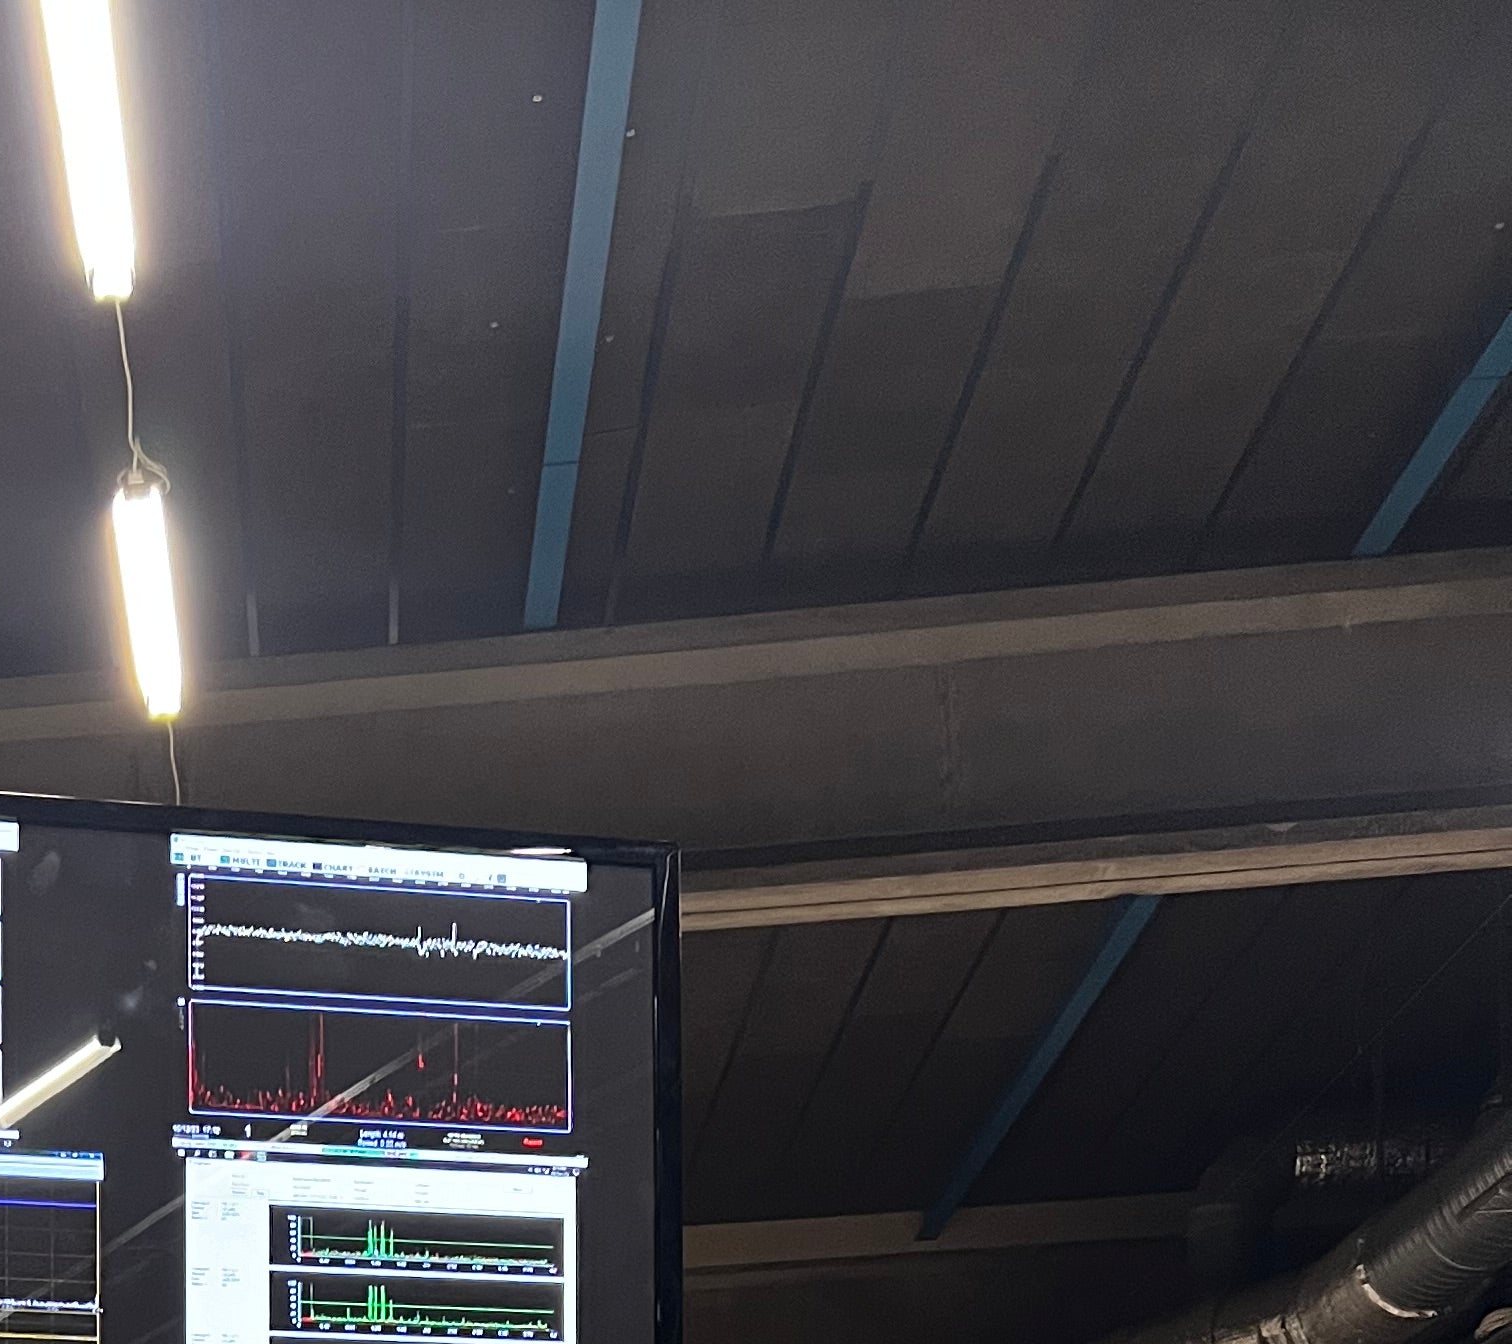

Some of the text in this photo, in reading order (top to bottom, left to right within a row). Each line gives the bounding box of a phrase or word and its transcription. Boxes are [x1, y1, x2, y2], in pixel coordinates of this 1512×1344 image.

[277, 860, 307, 869] TRACK
[323, 864, 353, 872] CHART
[368, 867, 397, 875] BATCH
